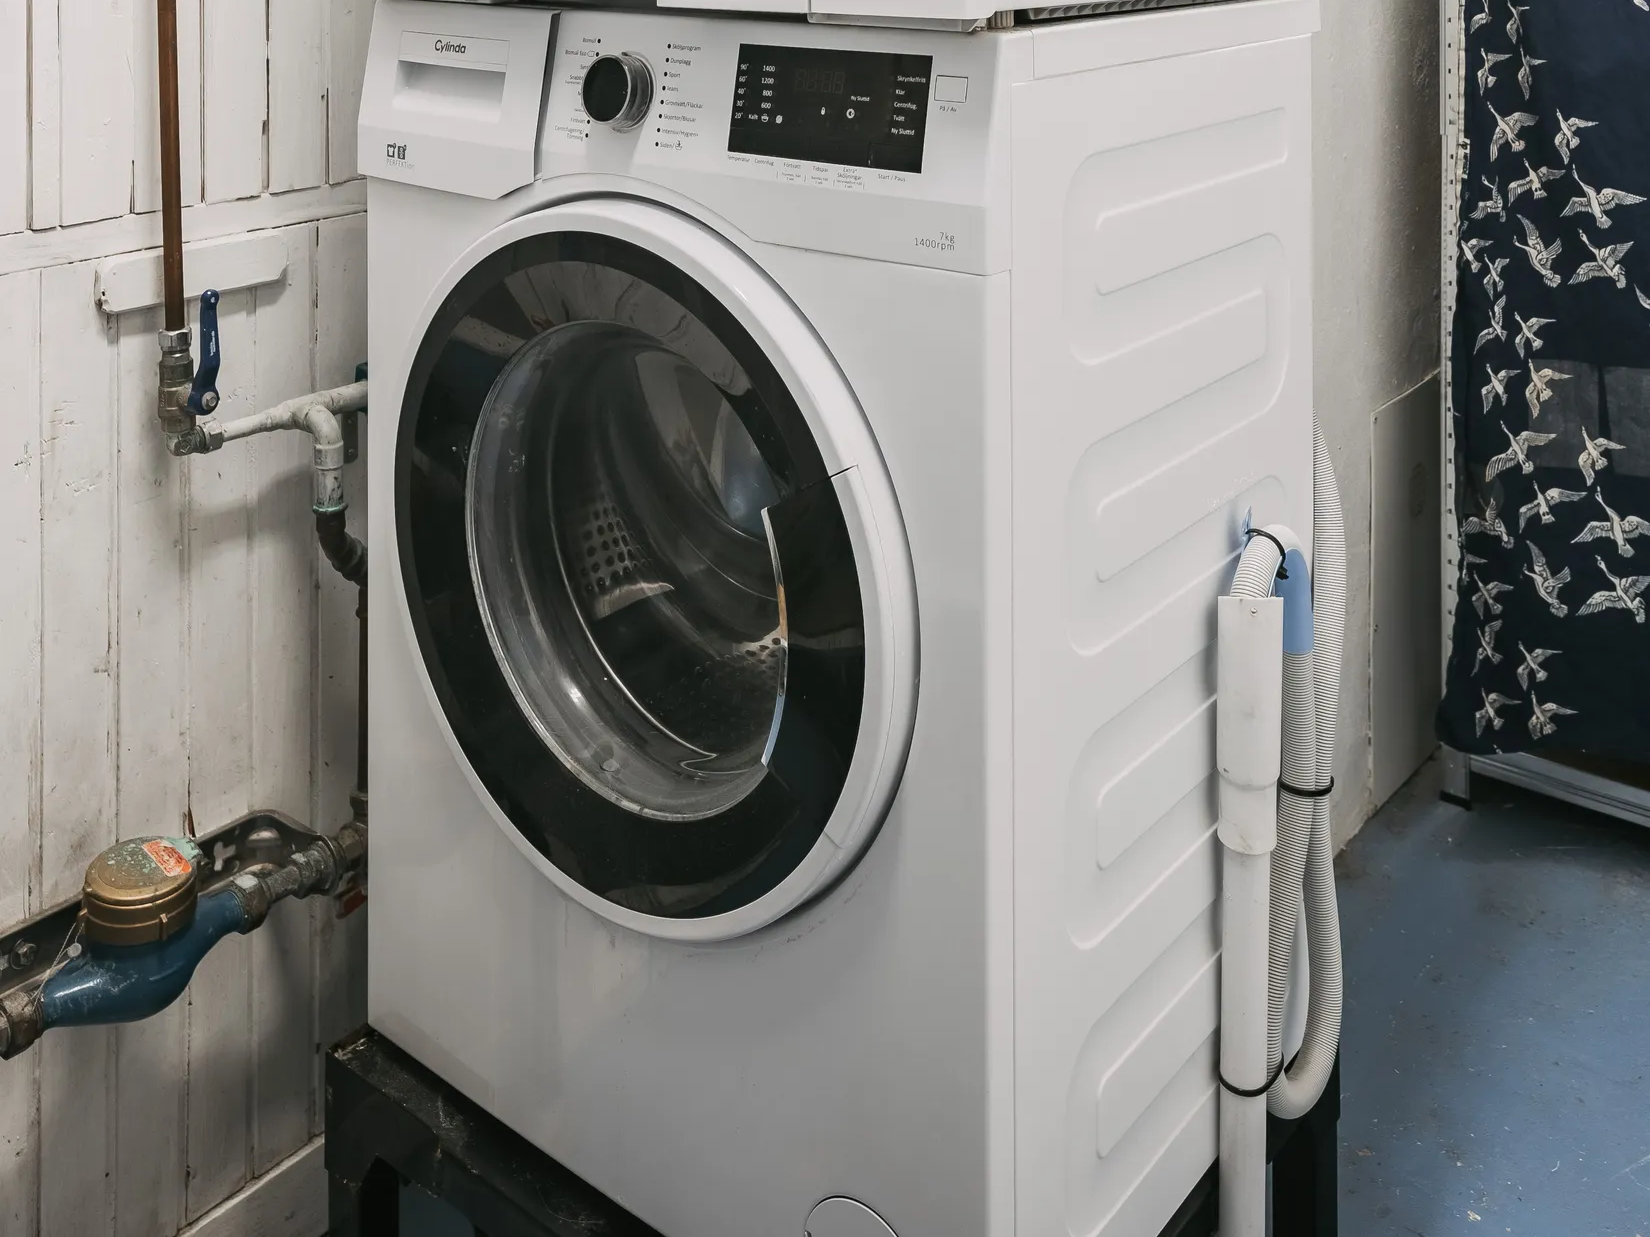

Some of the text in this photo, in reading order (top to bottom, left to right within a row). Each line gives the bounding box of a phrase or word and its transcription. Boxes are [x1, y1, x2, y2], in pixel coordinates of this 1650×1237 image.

[434, 39, 467, 54] Cylinda
[762, 89, 773, 97] 800
[760, 101, 771, 109] 600
[891, 127, 898, 135] Ny
[877, 173, 890, 181] Start
[939, 231, 955, 245] 7kg
[914, 237, 955, 251] 1400rpm
